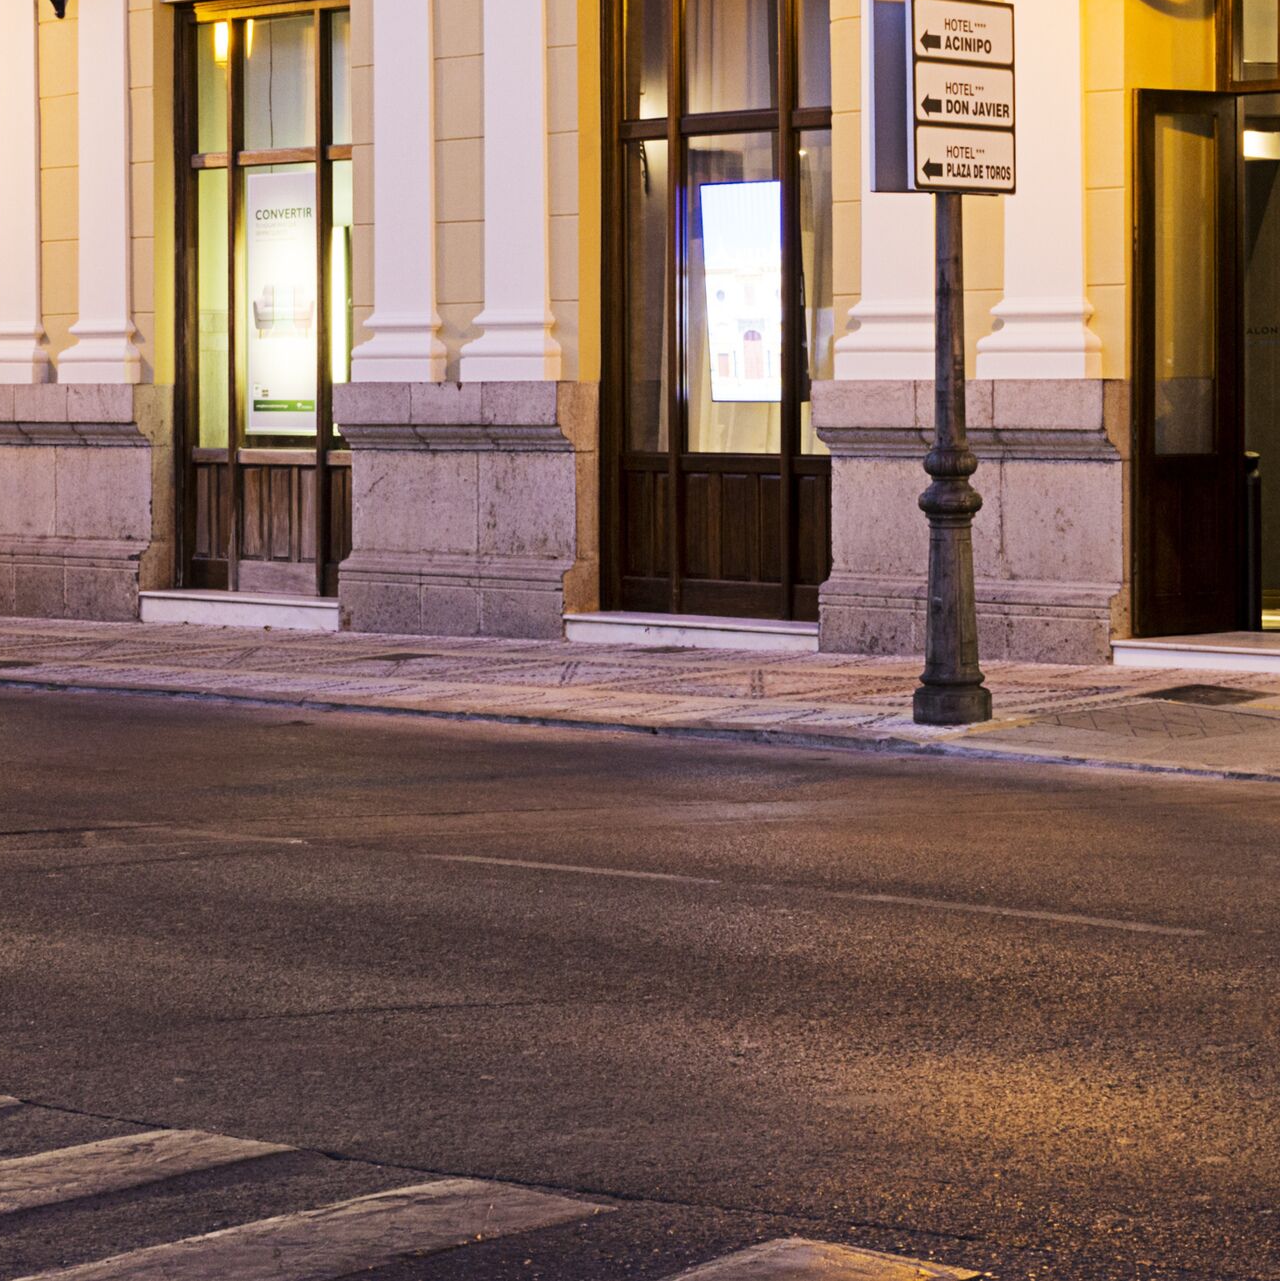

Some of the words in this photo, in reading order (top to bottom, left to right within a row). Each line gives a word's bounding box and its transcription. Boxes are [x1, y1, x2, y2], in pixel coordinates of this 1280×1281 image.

[944, 18, 973, 33] HOTEL
[945, 35, 992, 54] ACINIPO
[945, 81, 974, 97] HOTEL
[946, 99, 969, 115] DON
[972, 102, 1010, 118] JAVIER
[946, 145, 975, 160] HOTEL
[946, 163, 971, 178] PLAZA
[973, 164, 983, 179] DE
[985, 165, 1011, 180] TOROS
[255, 207, 313, 220] CONVERTIR
